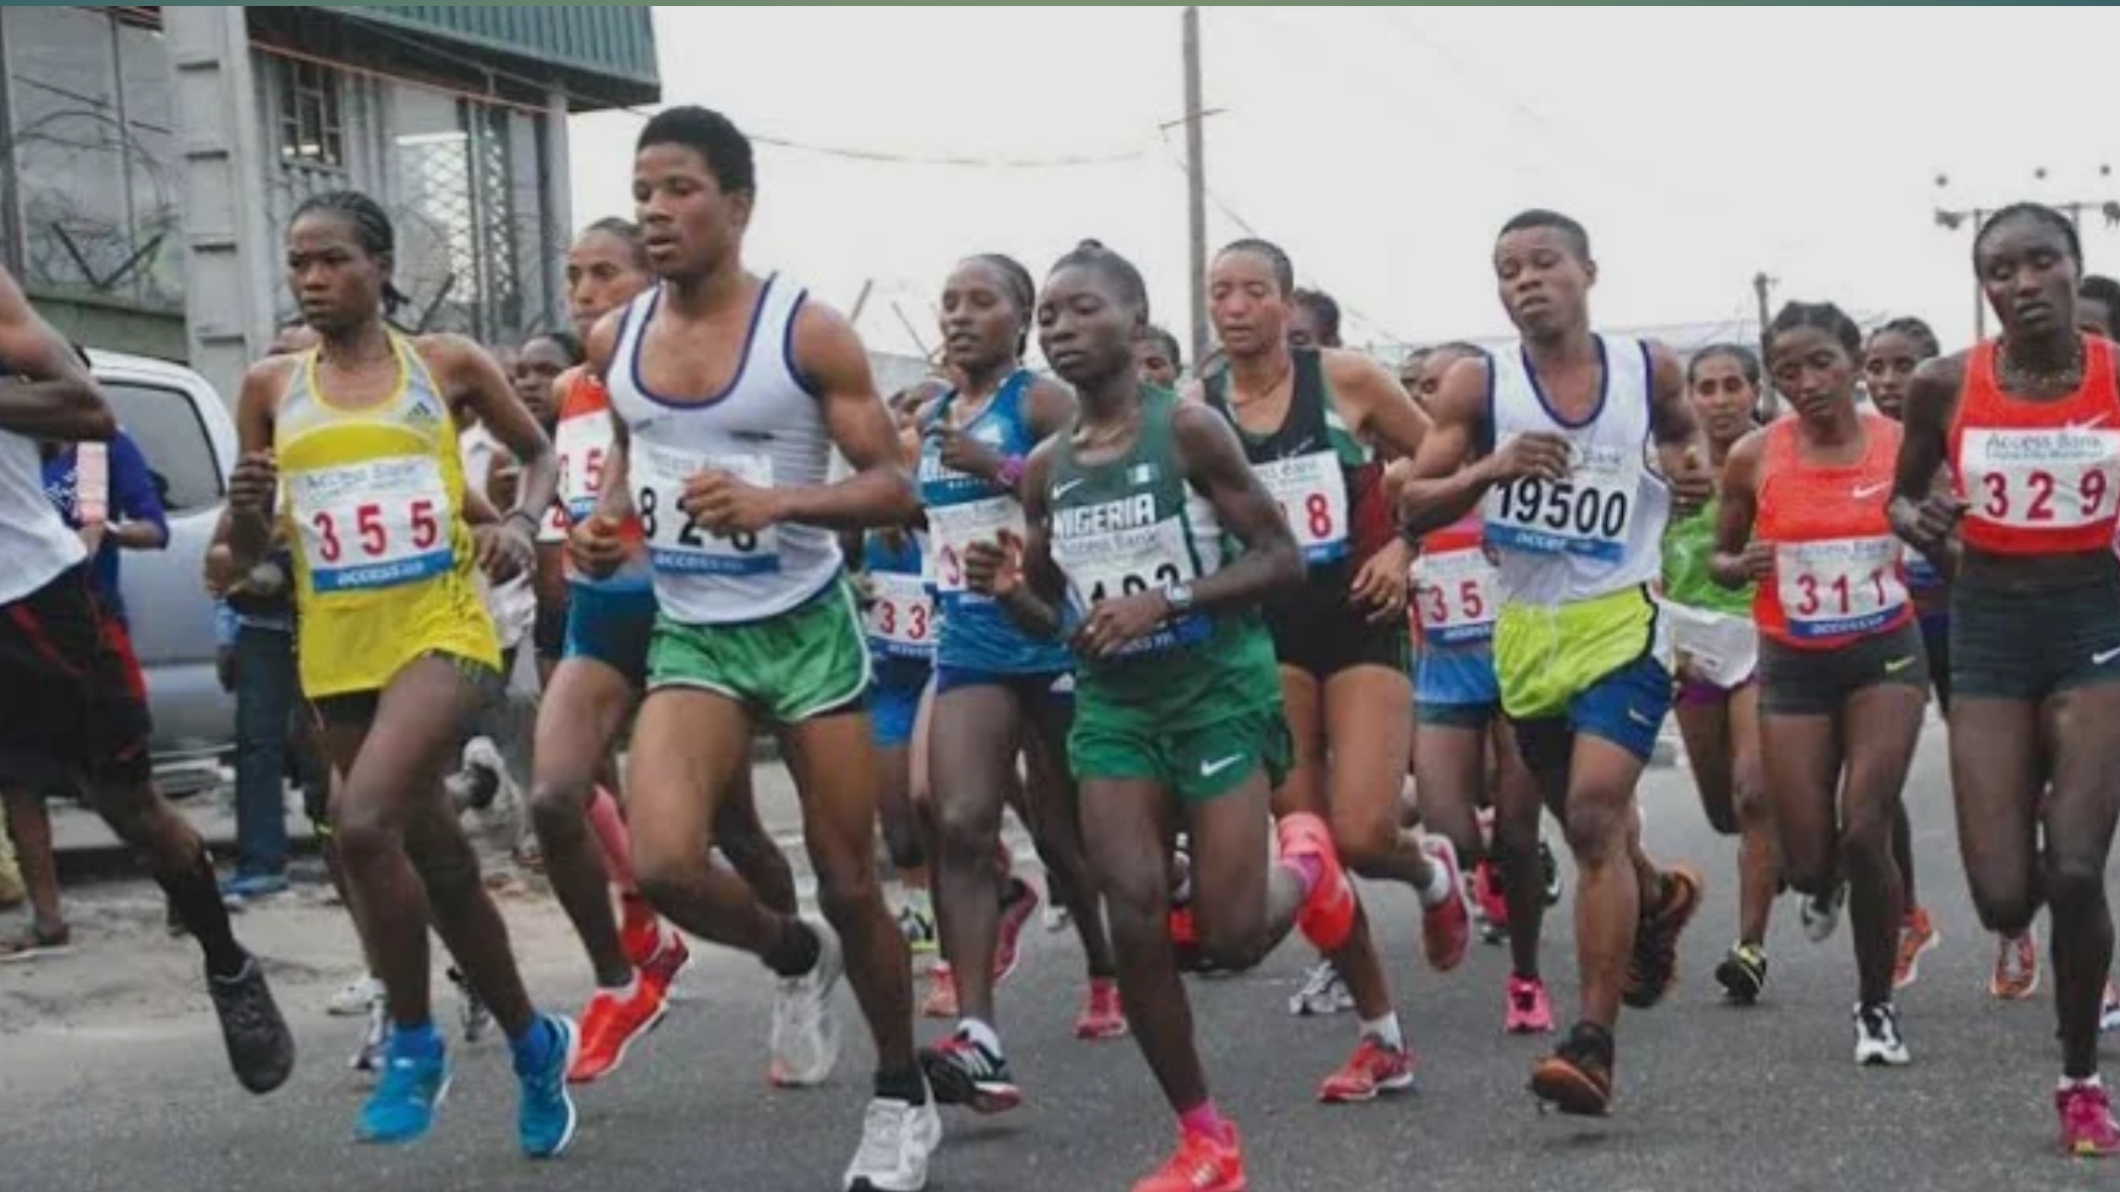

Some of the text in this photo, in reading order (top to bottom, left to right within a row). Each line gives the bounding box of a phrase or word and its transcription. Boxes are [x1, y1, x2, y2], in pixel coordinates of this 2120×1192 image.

[1986, 433, 2050, 449] Access
[1052, 493, 1156, 539] NIGERIA
[1497, 477, 1628, 538] 19500
[1982, 468, 2107, 521] 329
[313, 499, 438, 562] 355
